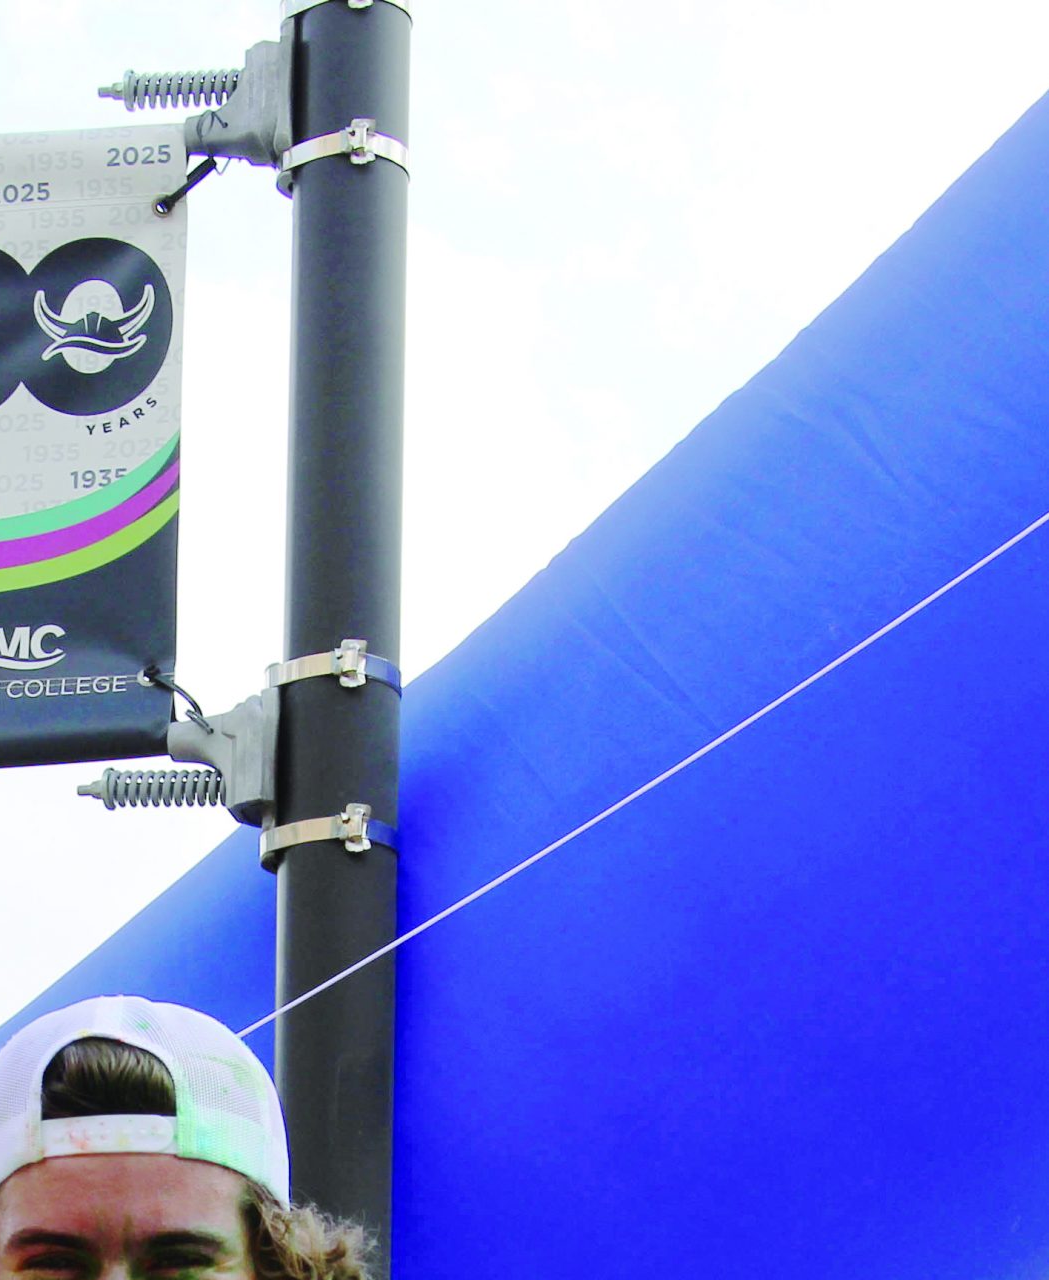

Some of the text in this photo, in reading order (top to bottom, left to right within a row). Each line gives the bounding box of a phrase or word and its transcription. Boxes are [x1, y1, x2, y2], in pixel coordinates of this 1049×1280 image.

[106, 144, 172, 168] 2025
[85, 395, 158, 436] YEARS
[6, 675, 128, 699] COLLEGE
